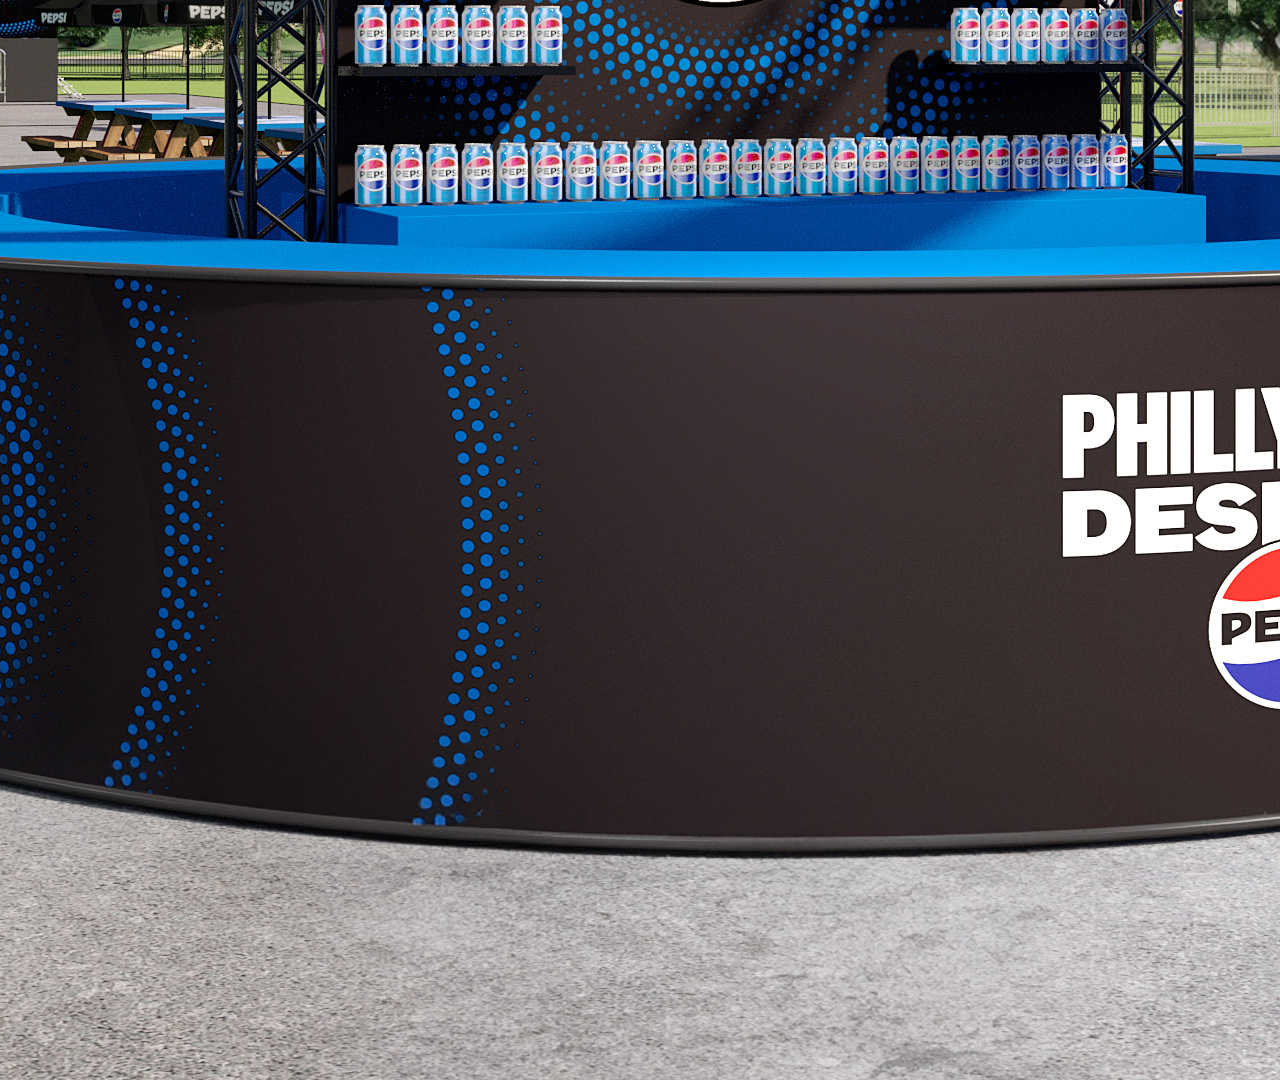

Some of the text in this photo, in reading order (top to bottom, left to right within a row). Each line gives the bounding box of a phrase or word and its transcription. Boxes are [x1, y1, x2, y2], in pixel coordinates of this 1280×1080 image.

[41, 11, 67, 24] PEPSI
[359, 30, 386, 38] PEPS
[395, 30, 422, 38] PEPS
[431, 30, 457, 38] PEPS
[467, 30, 492, 38] PEPS
[502, 30, 527, 38] PEPS
[537, 30, 562, 38] PEPS
[705, 164, 729, 172] PEPS
[738, 163, 761, 171] PEPS
[770, 163, 793, 171] PEPS
[802, 162, 825, 170] PEPS
[834, 161, 857, 169] PEPS
[865, 161, 888, 169] PEPS
[896, 160, 919, 168] PEPS
[467, 168, 492, 177] PEPS
[502, 168, 527, 176] PEPS
[537, 167, 562, 175] PEPS
[571, 166, 596, 175] PEPS
[605, 166, 629, 174] PEPS
[638, 165, 663, 173] PEPS
[672, 164, 696, 173] PEPS
[359, 170, 386, 179] PEPS
[395, 170, 422, 178] PEPS
[431, 169, 457, 177] PEPS
